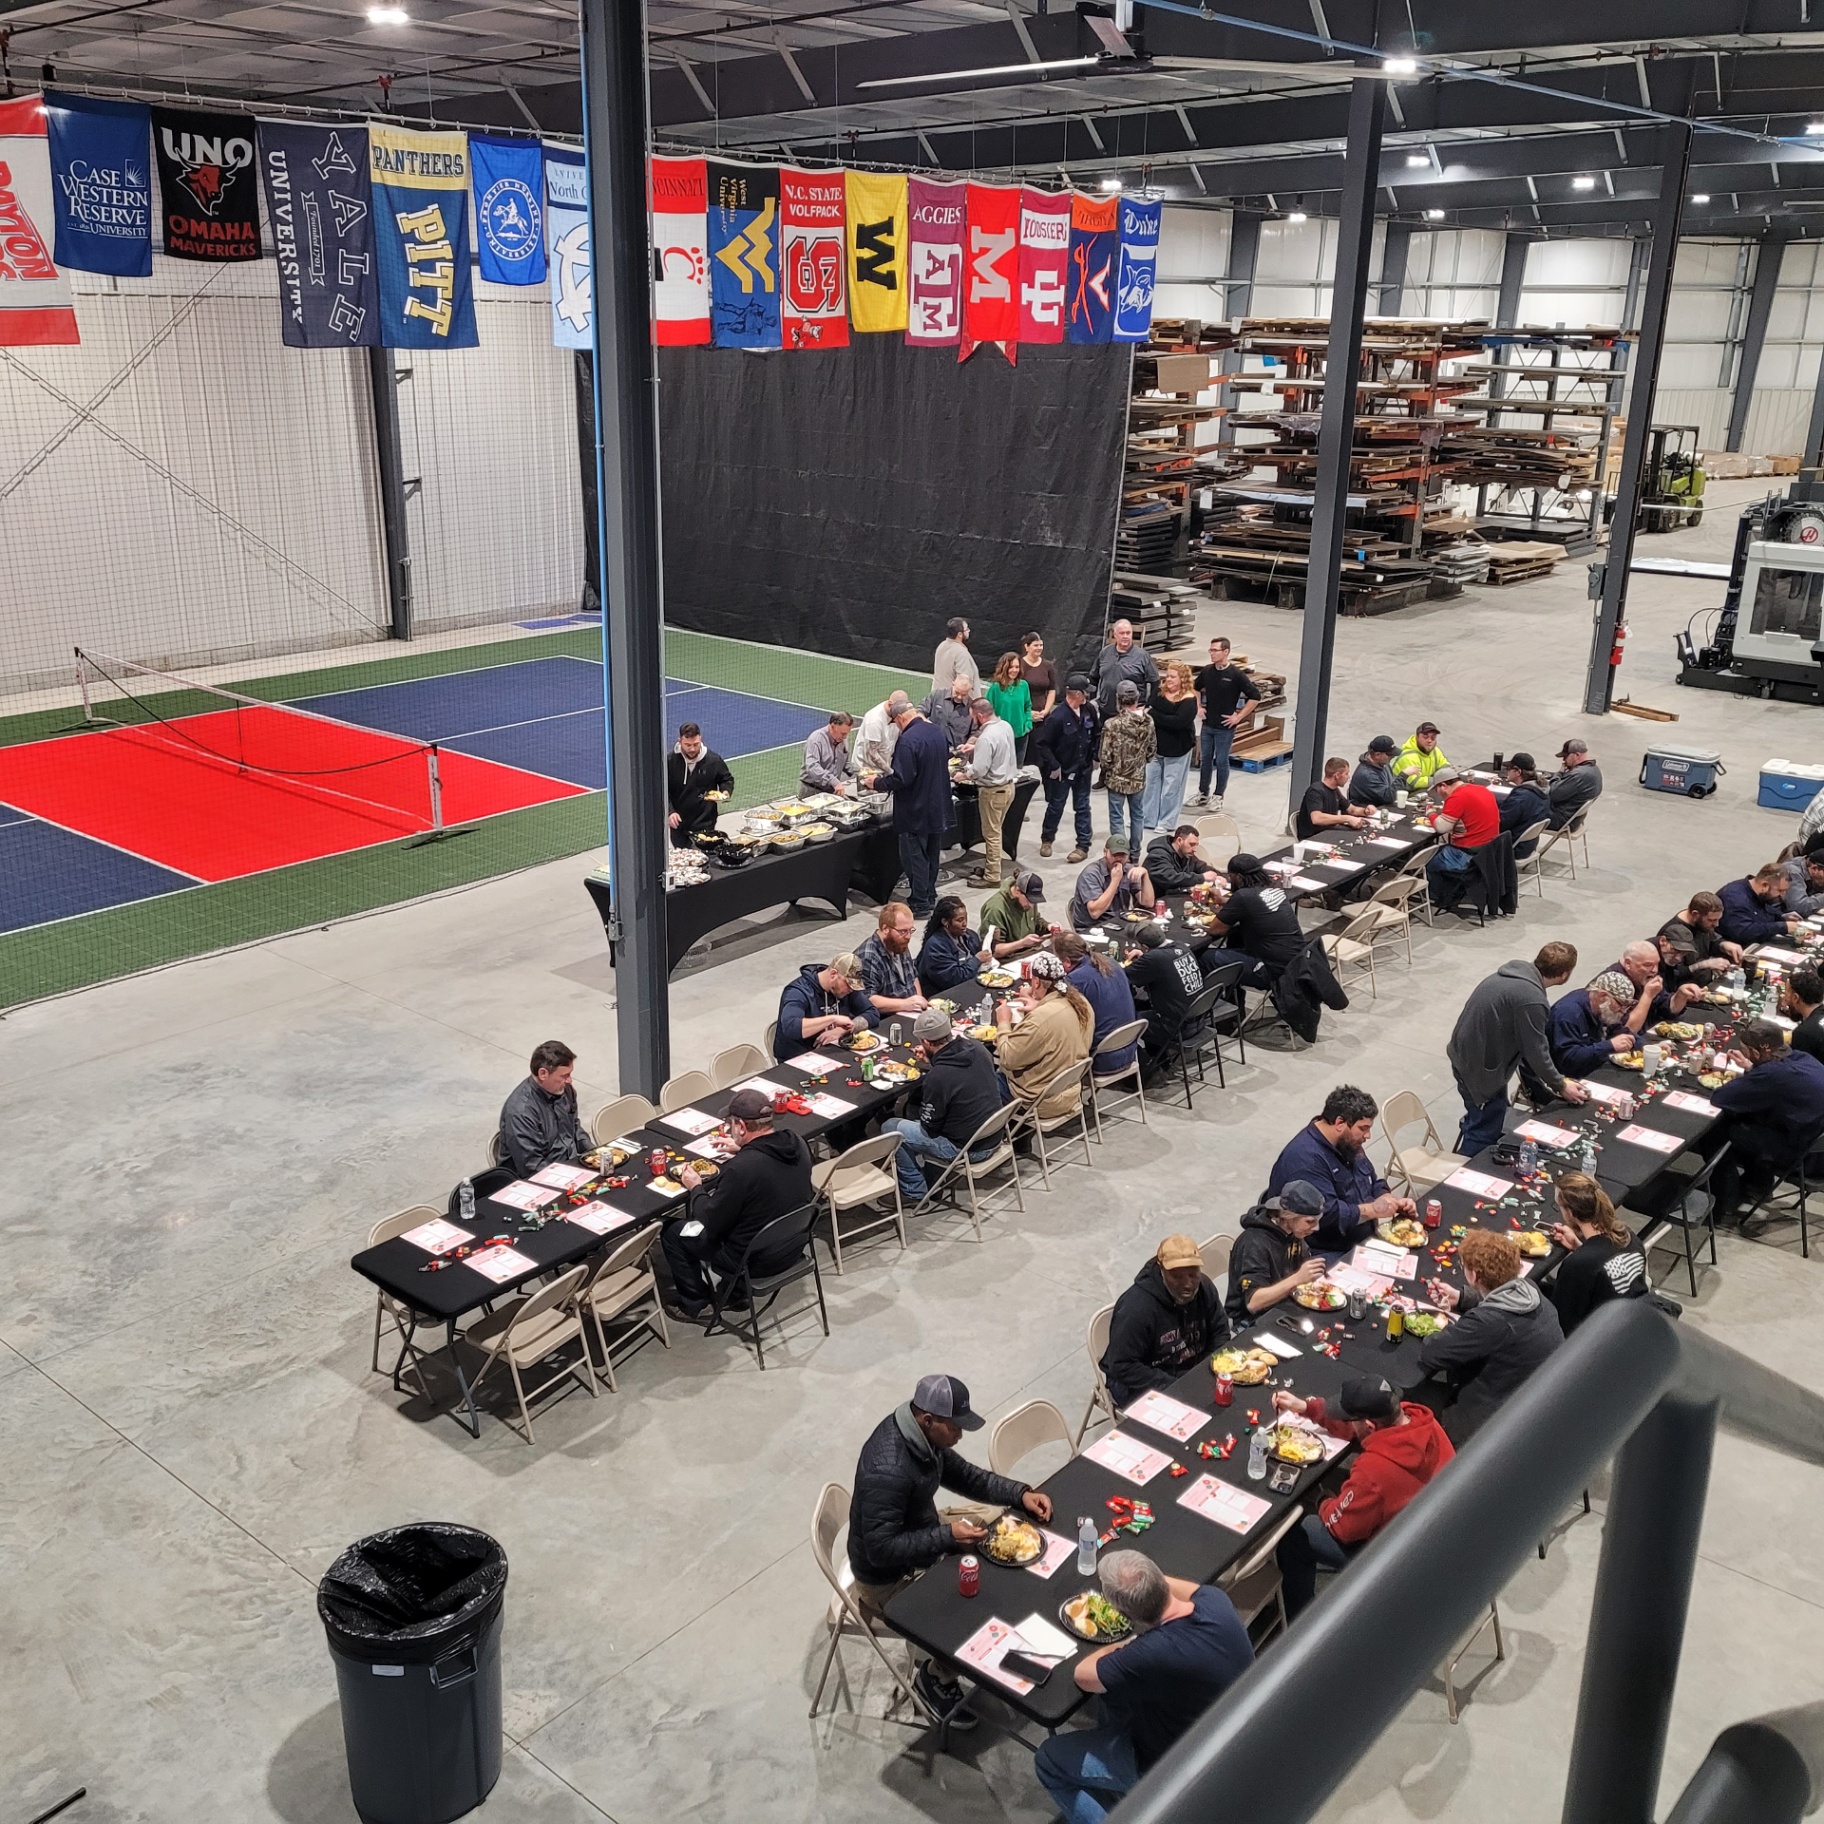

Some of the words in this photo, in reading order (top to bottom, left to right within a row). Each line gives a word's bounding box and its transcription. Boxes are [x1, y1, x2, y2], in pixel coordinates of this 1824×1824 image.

[161, 127, 253, 167] UNO
[70, 159, 121, 187] CASE
[372, 145, 465, 177] PANTHERS
[57, 173, 148, 206] WESTERN
[481, 181, 511, 223] FRONTIER
[514, 182, 540, 224] NURSING
[550, 181, 579, 199] North
[728, 178, 738, 223] Virginia
[739, 179, 747, 205] West
[785, 184, 808, 200] N.C.
[809, 187, 843, 201] STATE
[69, 195, 146, 225] RESERVE
[912, 204, 962, 224] AGGIES
[1124, 208, 1158, 236] Duke
[90, 223, 147, 236] UNIVERSITY
[168, 215, 255, 240] OMAHA
[310, 211, 321, 246] Founded
[311, 131, 369, 342] YALE
[170, 236, 256, 257] MAVERICKS
[485, 231, 538, 257] UNIVERSITY
[396, 203, 454, 337] PITT
[1173, 956, 1189, 970] BUY
[1177, 962, 1199, 978] DUCK
[1181, 972, 1198, 985] FEED
